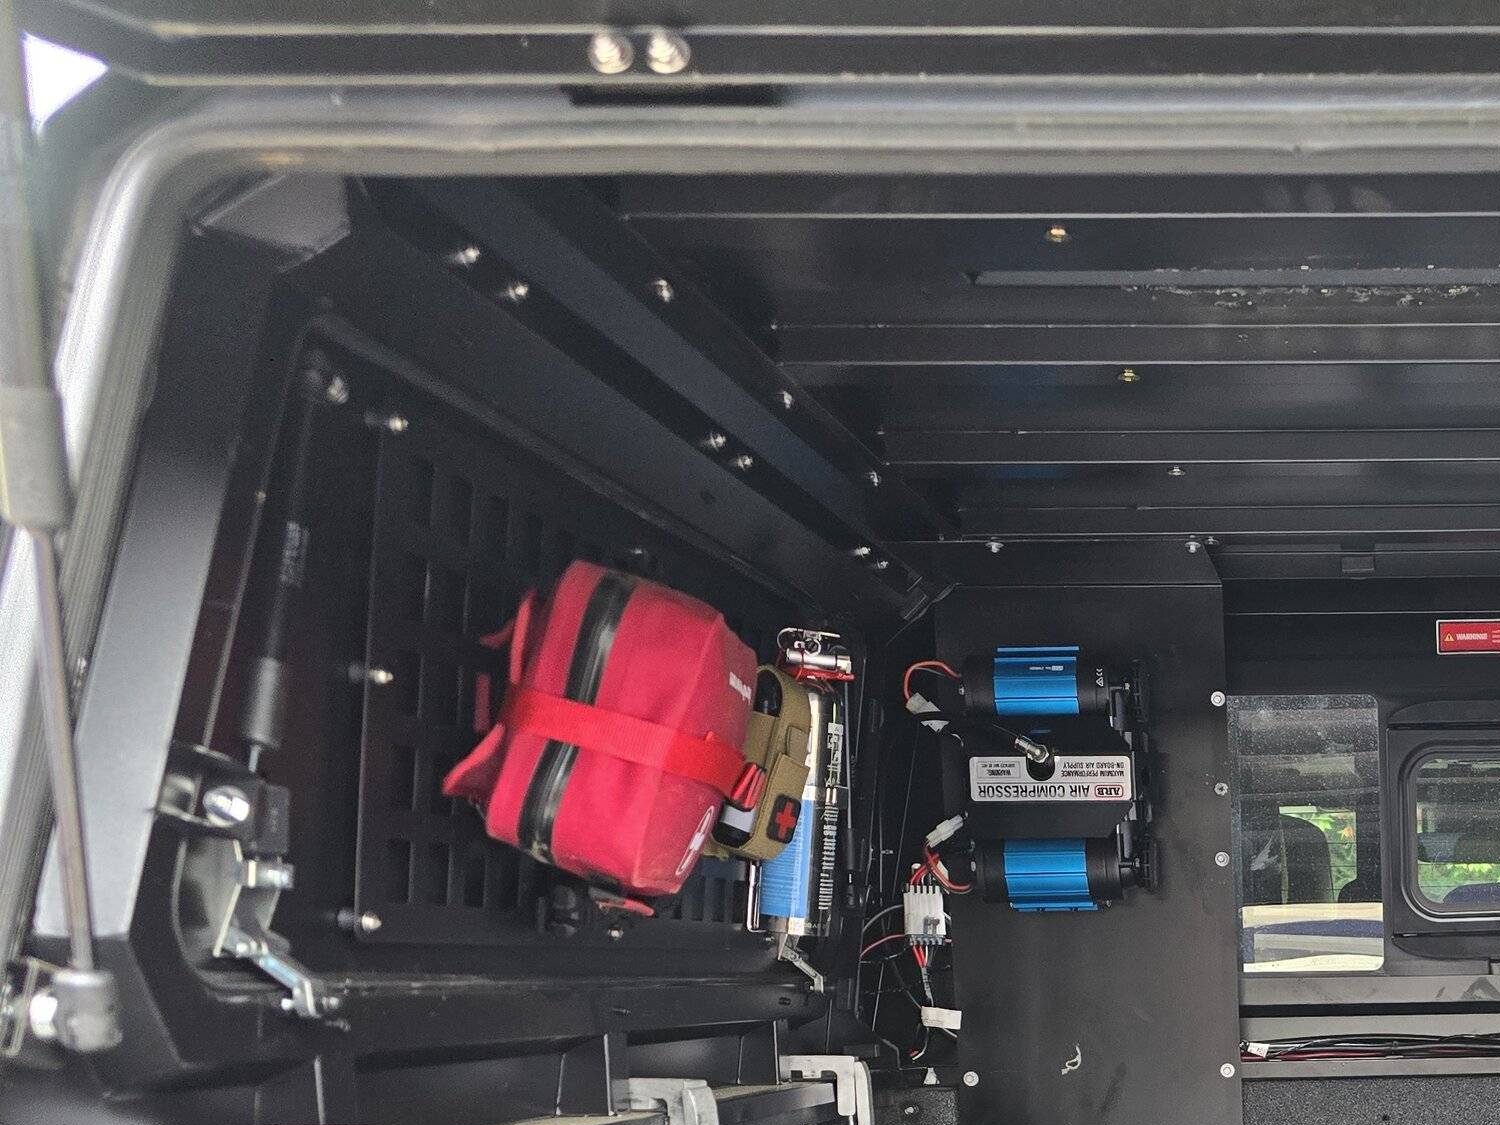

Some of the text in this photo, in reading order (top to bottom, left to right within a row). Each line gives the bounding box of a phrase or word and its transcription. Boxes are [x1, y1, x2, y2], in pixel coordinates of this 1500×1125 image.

[1061, 769, 1125, 778] MAXIMUM PERFORMANCE
[978, 785, 1121, 798] ARB AIR COMPRESSOR
